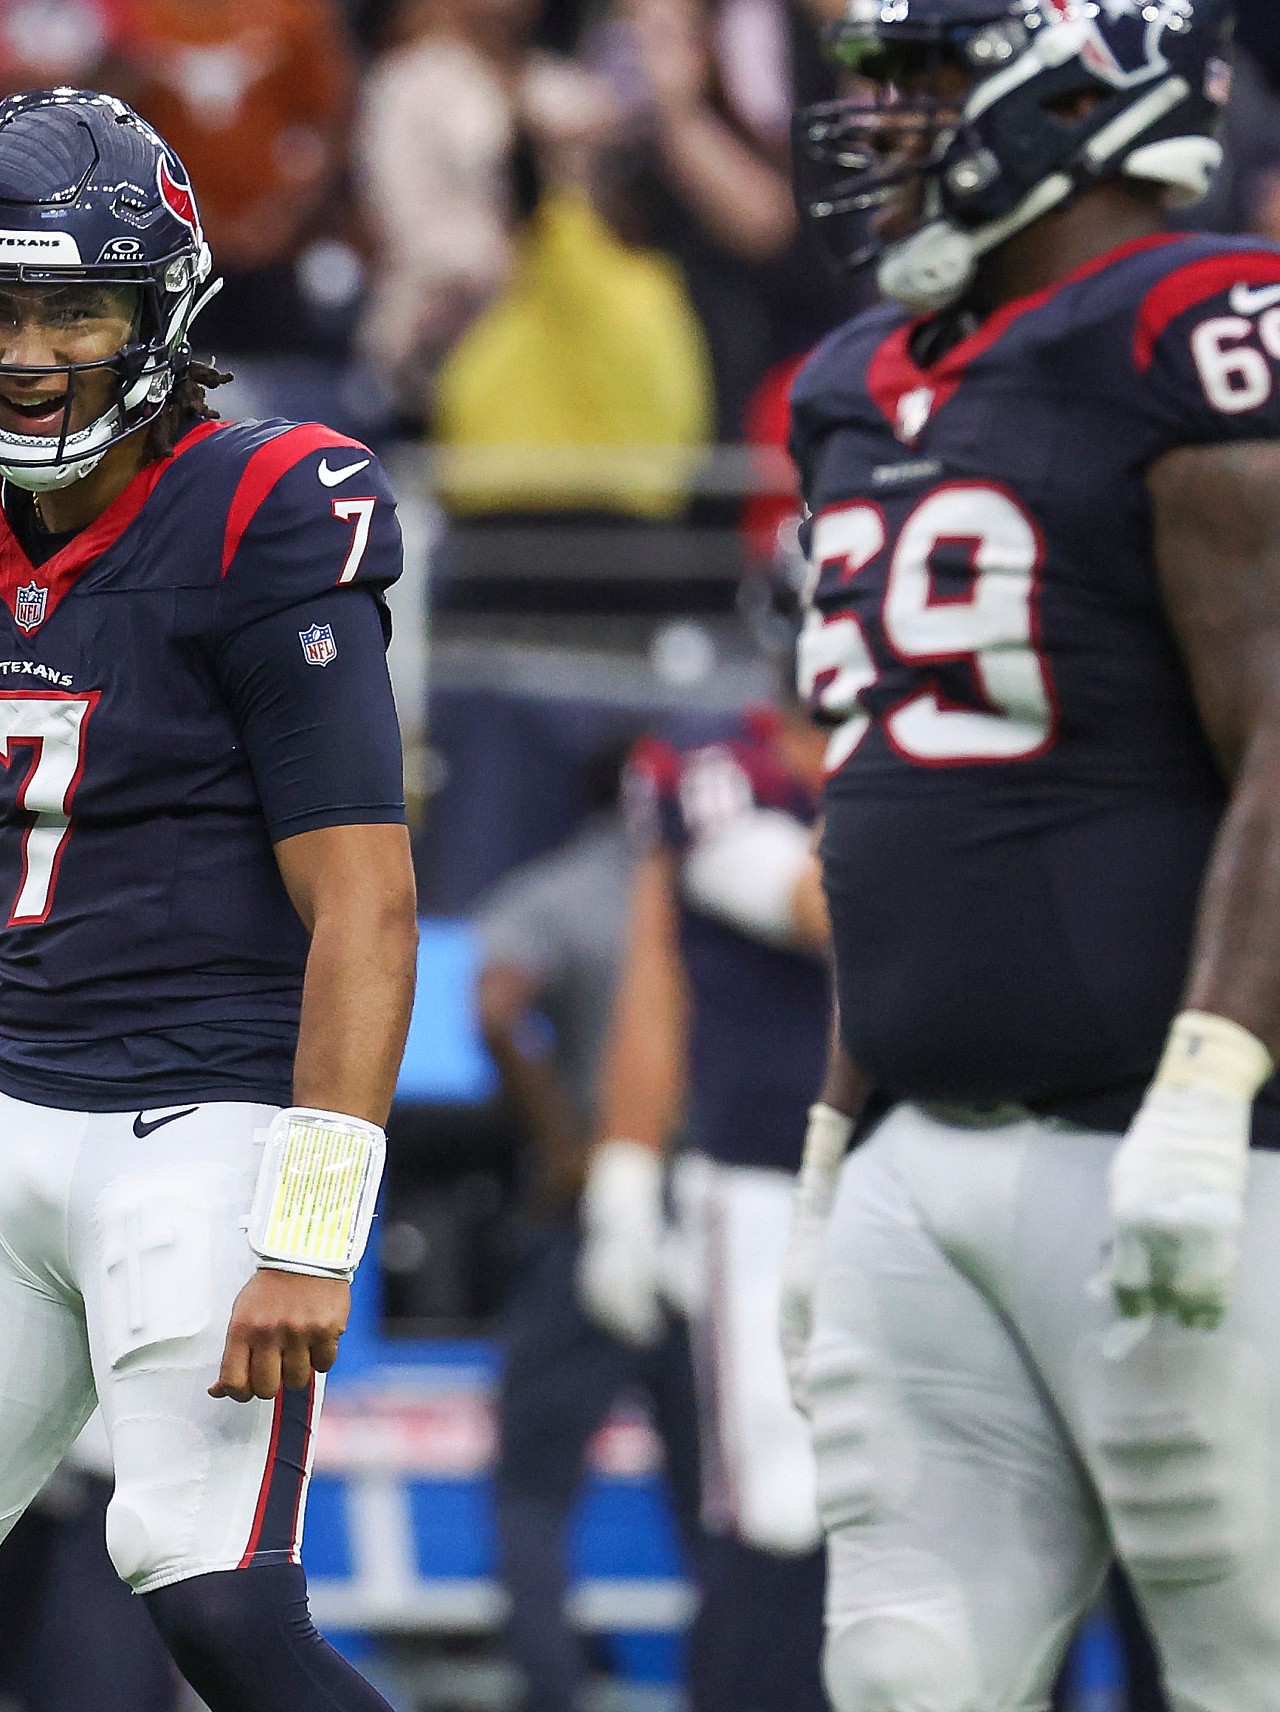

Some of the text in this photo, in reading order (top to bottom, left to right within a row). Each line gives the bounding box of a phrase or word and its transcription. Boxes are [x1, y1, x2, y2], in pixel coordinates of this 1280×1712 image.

[103, 252, 145, 260] OAKLEY
[331, 496, 377, 587] 7
[20, 602, 40, 622] NFL
[307, 640, 334, 660] NFL
